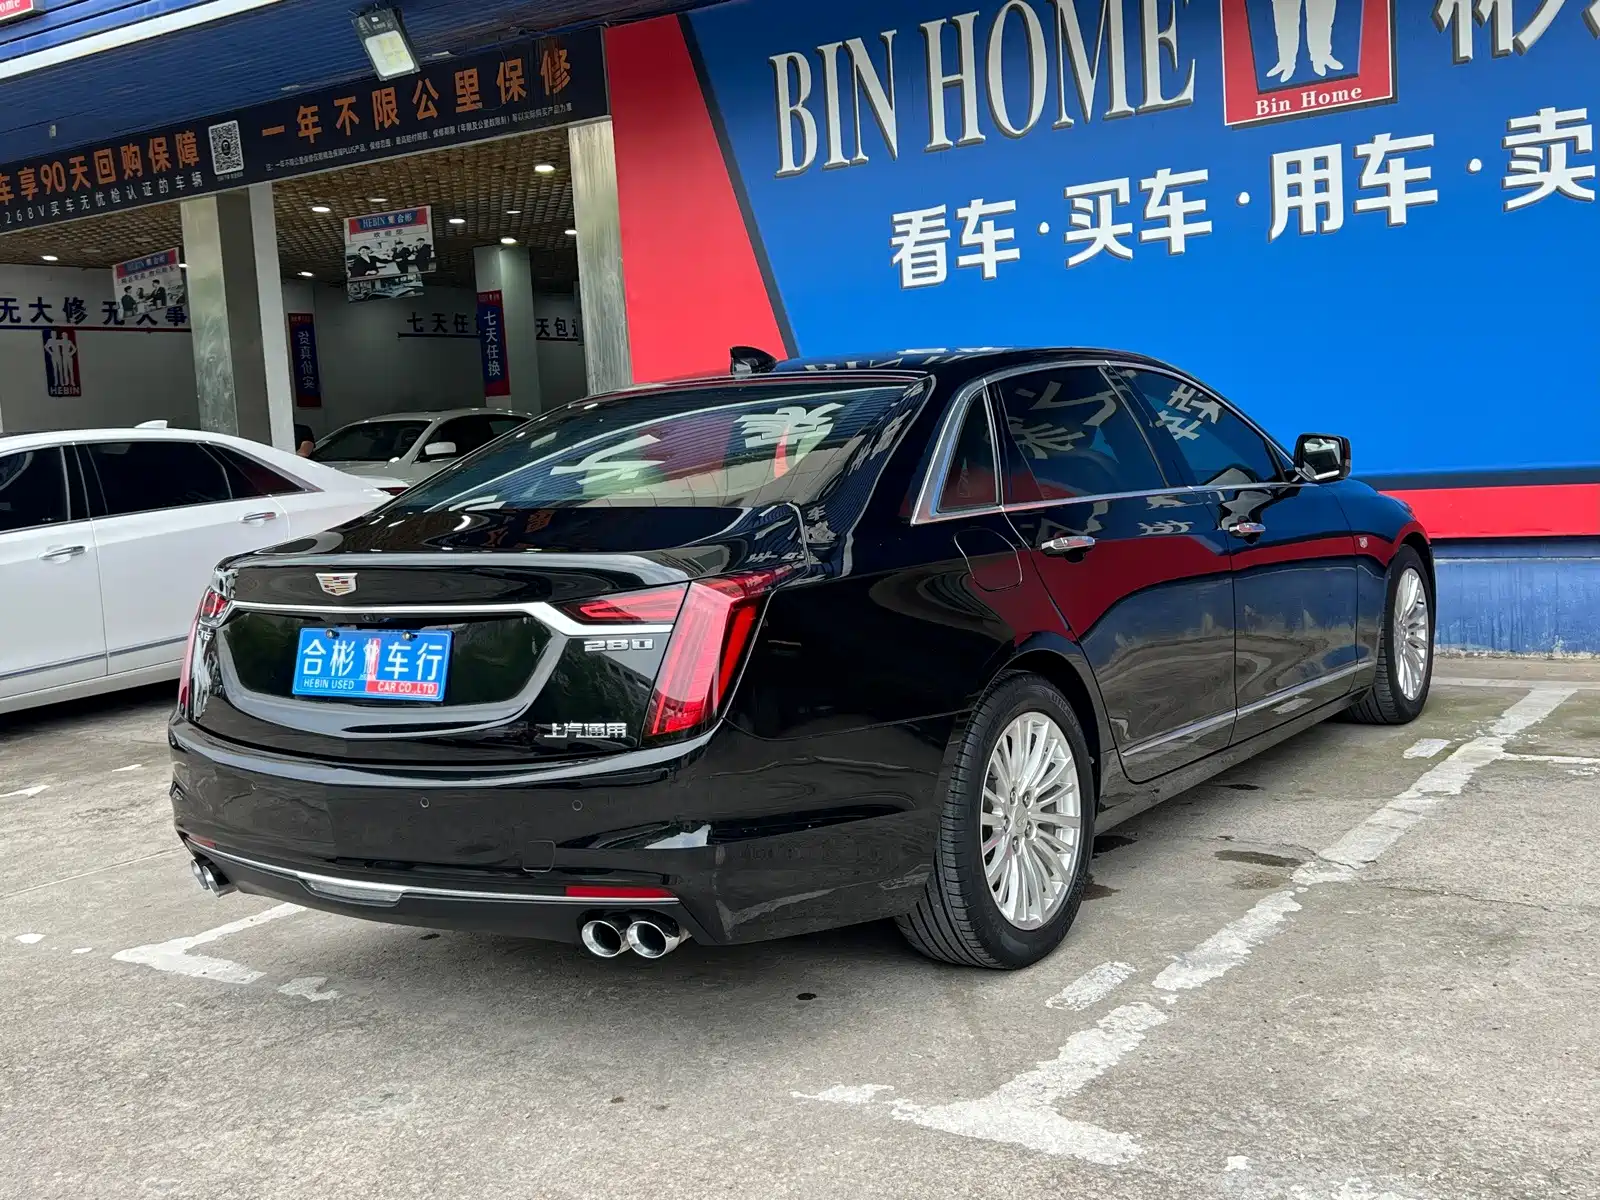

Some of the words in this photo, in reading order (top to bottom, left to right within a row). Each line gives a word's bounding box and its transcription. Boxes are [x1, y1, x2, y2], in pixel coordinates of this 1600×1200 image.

[0, 0, 21, 12] ome
[261, 48, 572, 144] 一年不限公里保修
[768, 29, 899, 177] BIN
[919, 0, 1196, 152] HOME
[1255, 95, 1292, 116] Bin
[1300, 86, 1363, 109] Home
[362, 216, 386, 228] HEBIN
[0, 296, 90, 325] 无大修
[407, 311, 479, 334] 七天任
[483, 310, 501, 377] 七天任换
[50, 386, 80, 395] HEBIN
[303, 639, 355, 677] 合彬
[384, 641, 443, 681] 车行
[303, 678, 329, 689] HEBIN
[331, 680, 355, 690] USED
[377, 681, 396, 692] CAR
[543, 722, 628, 739] 上汽通用
